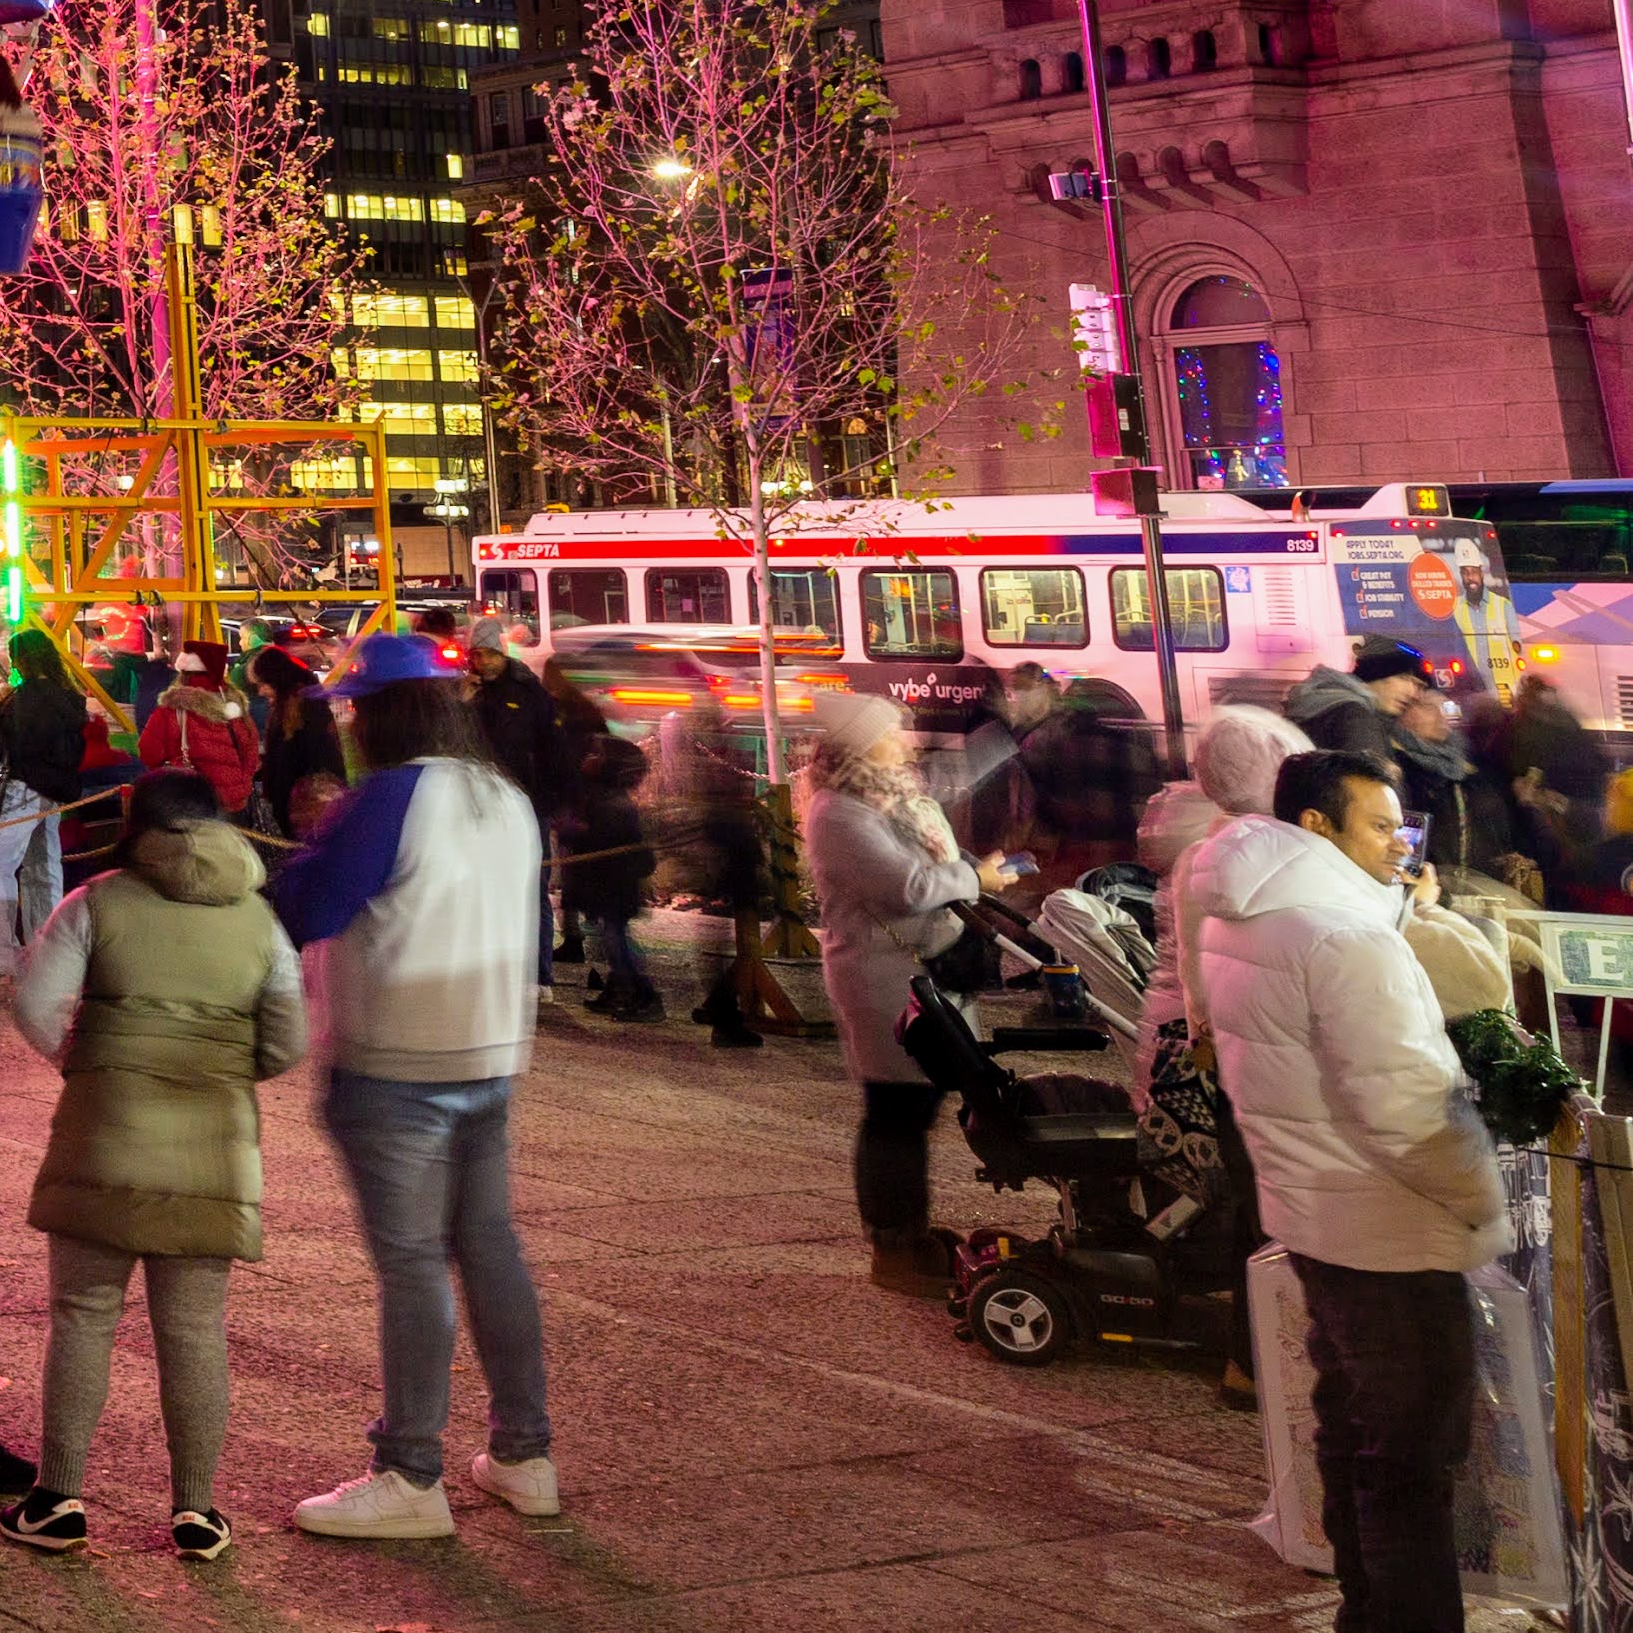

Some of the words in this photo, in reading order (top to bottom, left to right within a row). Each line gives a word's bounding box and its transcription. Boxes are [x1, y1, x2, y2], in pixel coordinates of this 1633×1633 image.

[1417, 488, 1438, 510] 31
[517, 543, 560, 558] SEPTA
[1286, 538, 1315, 552] 8139
[1346, 539, 1367, 549] APPLY
[1369, 539, 1395, 549] TODAY
[1426, 589, 1453, 600] SEPTA
[1487, 657, 1510, 669] 8139
[888, 677, 931, 702] vybe
[935, 684, 985, 705] urgen
